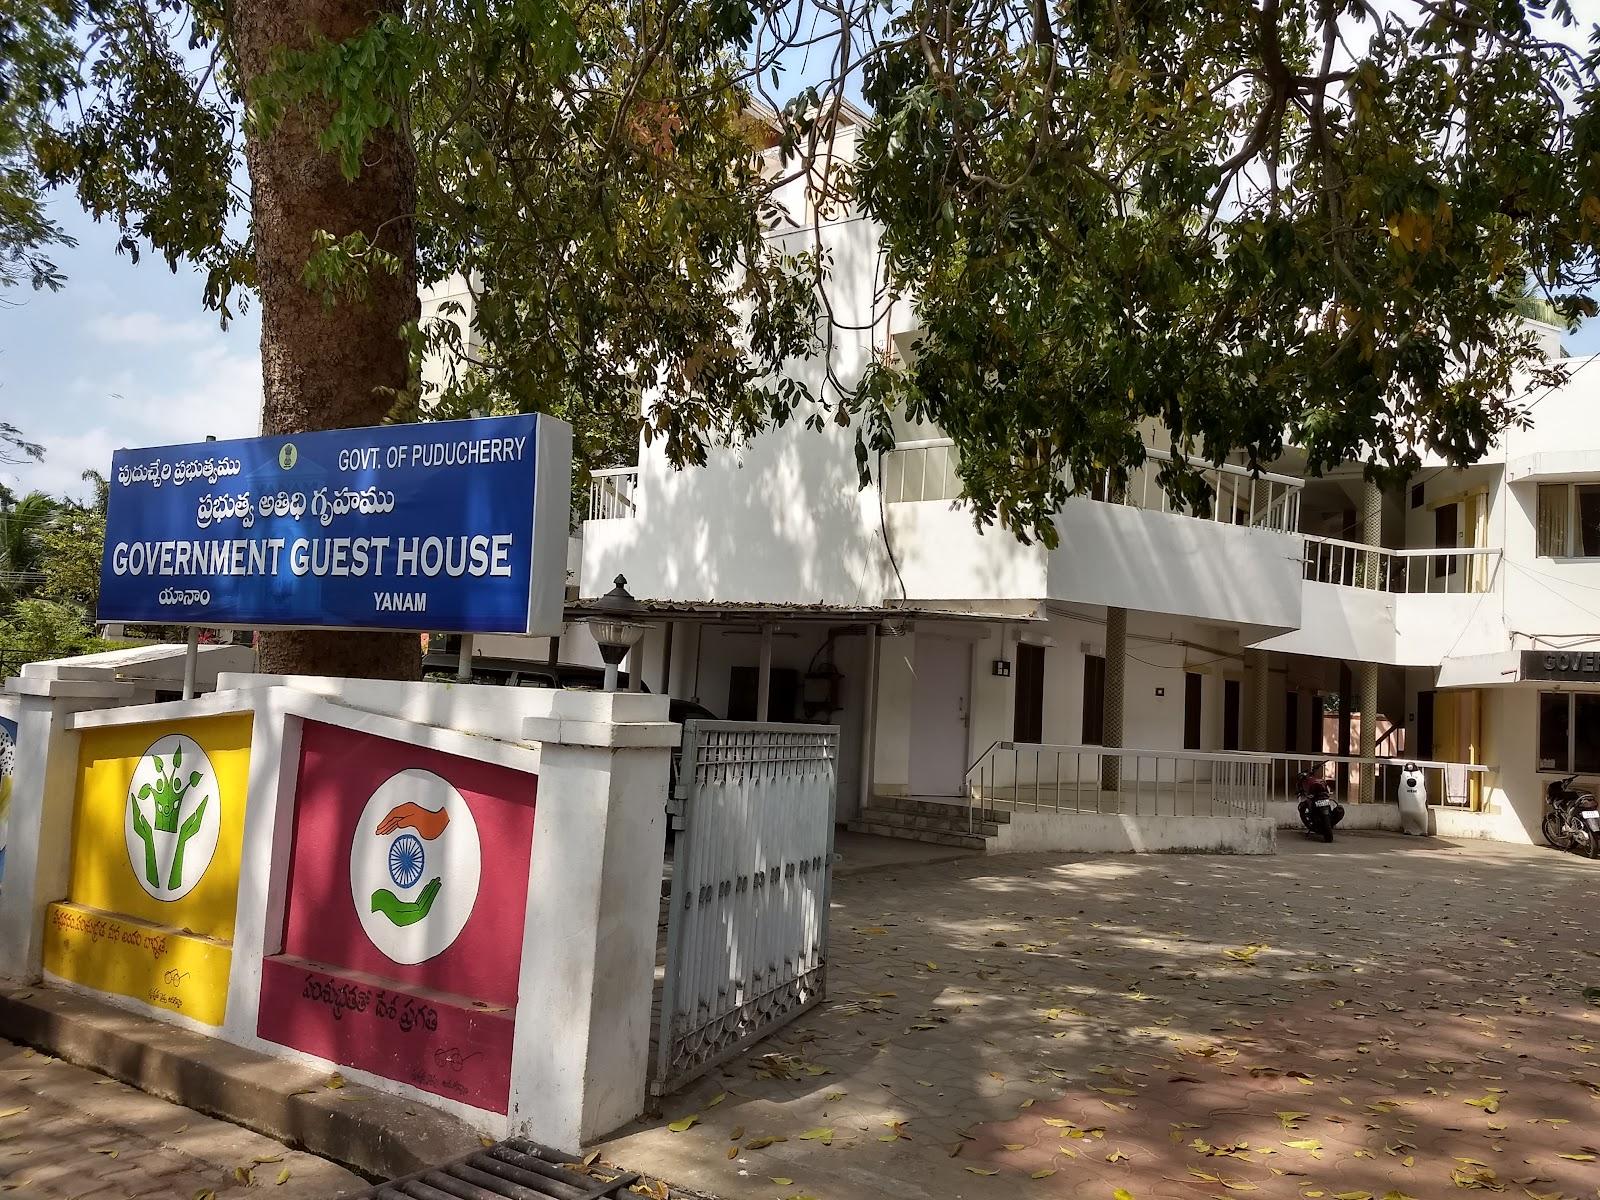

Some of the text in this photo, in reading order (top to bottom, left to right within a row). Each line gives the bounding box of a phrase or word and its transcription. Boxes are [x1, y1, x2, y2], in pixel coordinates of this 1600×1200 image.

[118, 459, 172, 487] పుదుచ్చేరి
[173, 457, 241, 486] ప్రభుత్వము
[338, 436, 527, 473] GOVT. OF PUDUCHERRY
[196, 491, 255, 530] ప్రభుత్వ
[311, 486, 395, 527] గృహము
[112, 532, 513, 578] GOVERNMENT GUEST HOUSE
[158, 587, 211, 606] యానాం
[373, 591, 427, 613] YANAM
[399, 998, 438, 1033] ప్రగతి
